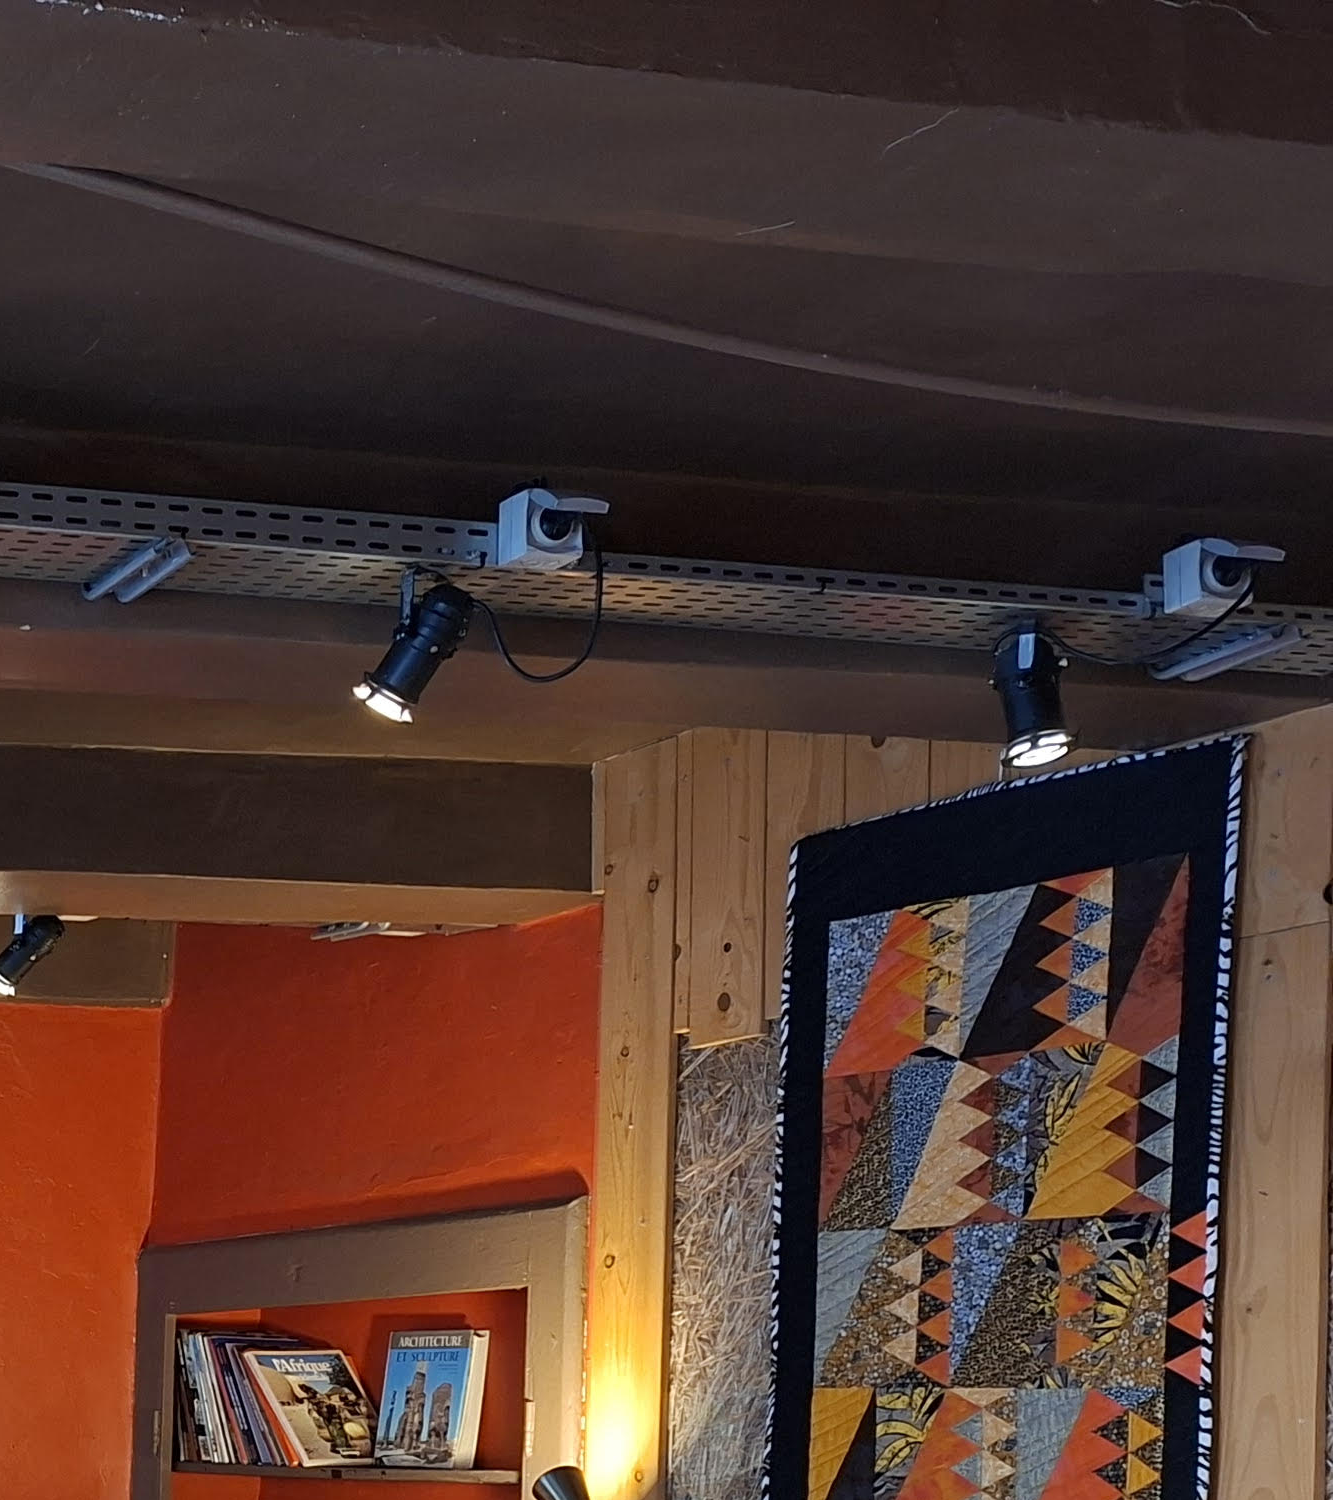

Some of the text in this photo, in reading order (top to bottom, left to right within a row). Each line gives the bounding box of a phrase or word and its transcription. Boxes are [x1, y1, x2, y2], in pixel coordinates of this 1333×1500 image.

[397, 1335, 463, 1348] ARCHITECTURE
[396, 1351, 460, 1362] ET SCULPTURE
